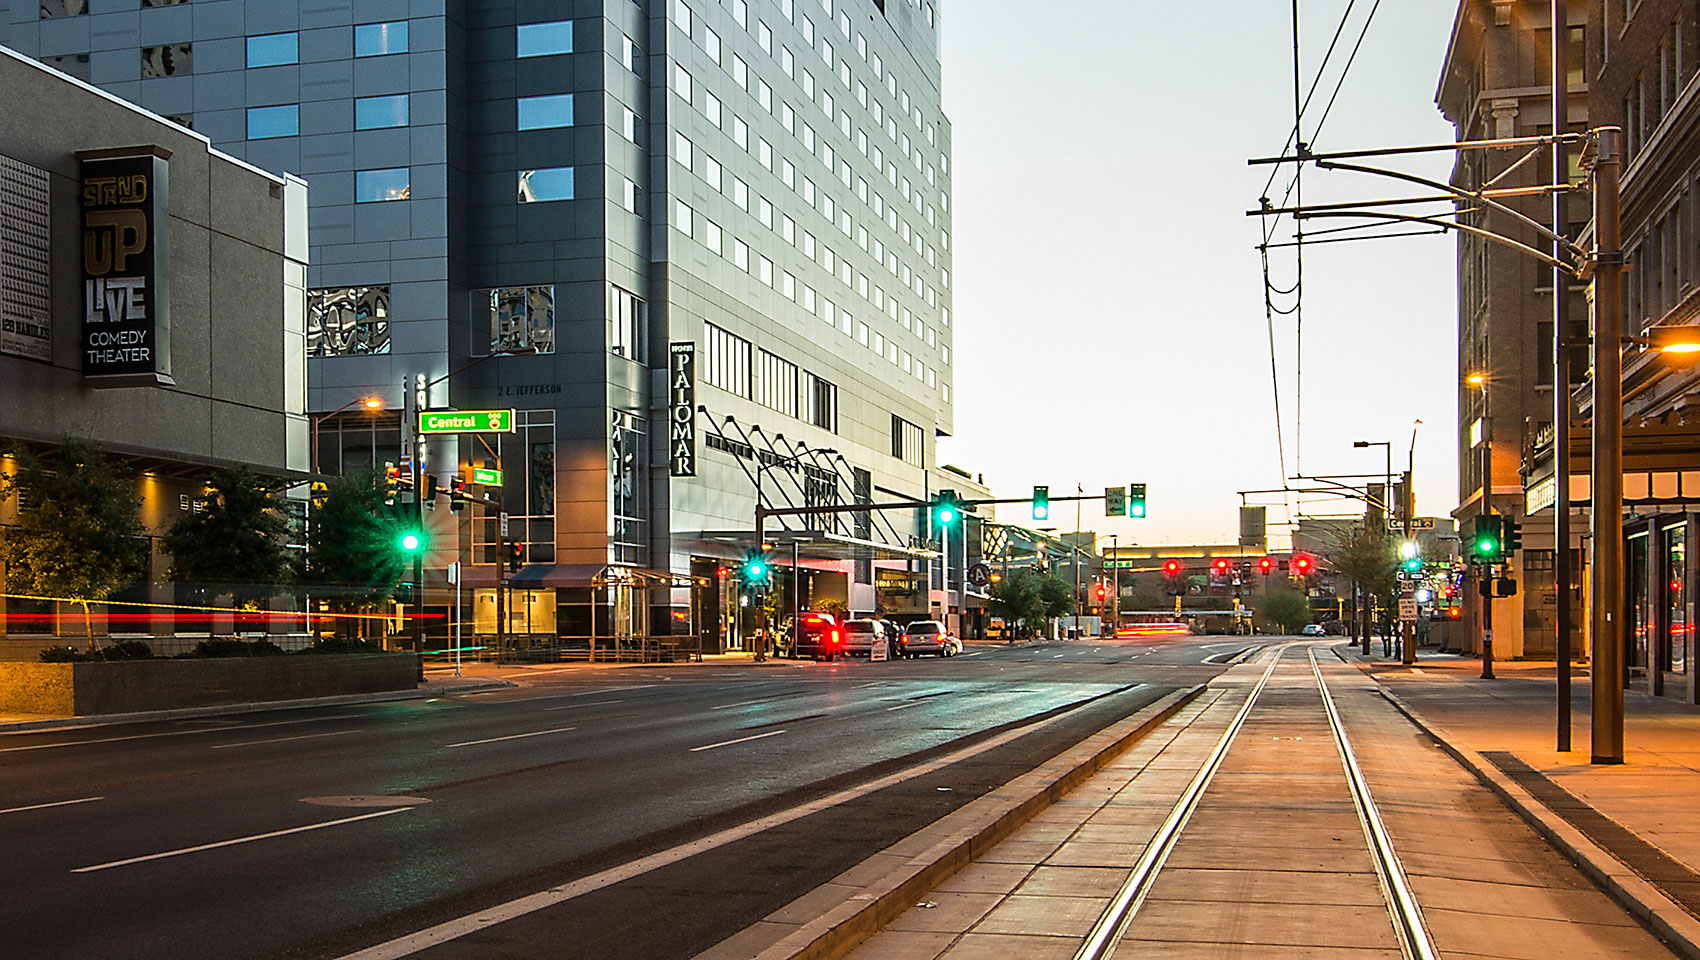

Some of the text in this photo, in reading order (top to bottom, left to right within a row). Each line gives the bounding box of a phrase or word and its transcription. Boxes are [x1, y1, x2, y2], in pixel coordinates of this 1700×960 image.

[84, 174, 147, 206] STAND
[85, 208, 147, 276] UP
[86, 275, 146, 323] LIVE
[89, 330, 147, 346] COMEDY
[87, 347, 150, 364] THEATER
[516, 384, 562, 396] JEFFERSON
[671, 354, 693, 474] PALOMAR
[428, 415, 476, 429] Central
[1108, 489, 1123, 497] ONE
[1108, 497, 1123, 505] WAY
[1390, 519, 1422, 527] Cenral
[975, 568, 986, 582] A
[1402, 582, 1413, 590] 20
